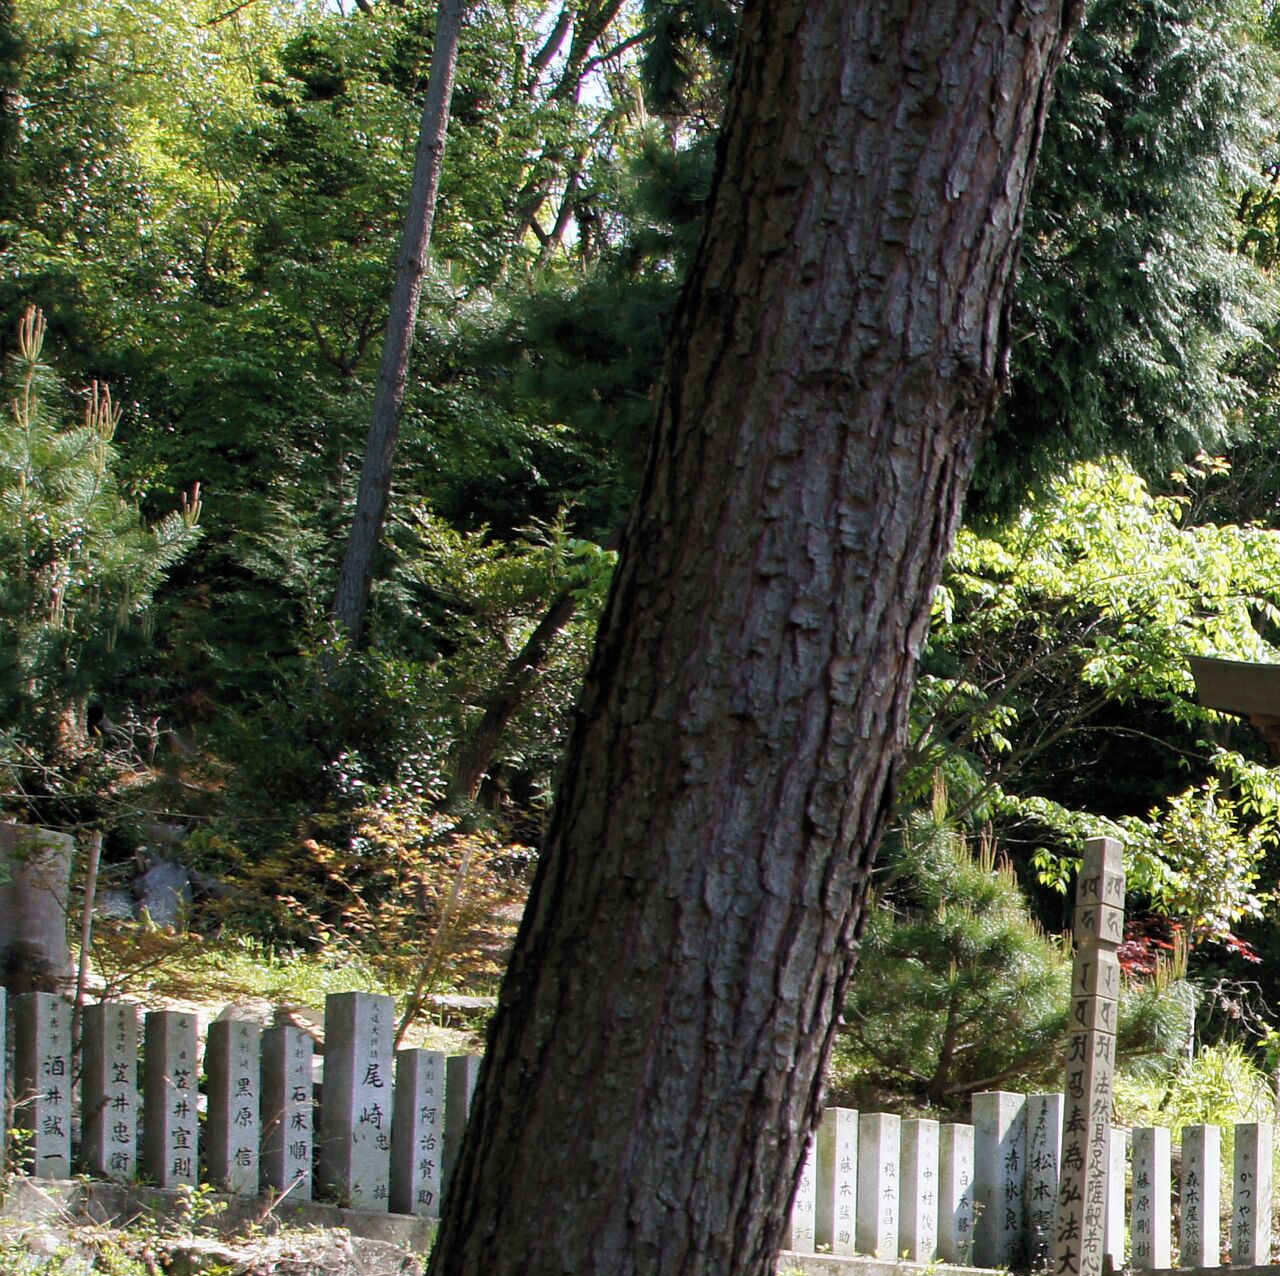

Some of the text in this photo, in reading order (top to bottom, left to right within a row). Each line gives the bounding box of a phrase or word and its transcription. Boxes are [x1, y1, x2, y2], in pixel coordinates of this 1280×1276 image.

[171, 1069, 192, 1178] 笠井宣則
[234, 1079, 253, 1167] 黒原信
[1185, 1171, 1200, 1258] 森本屋旅館
[1237, 1172, 1253, 1255] かつや旅館
